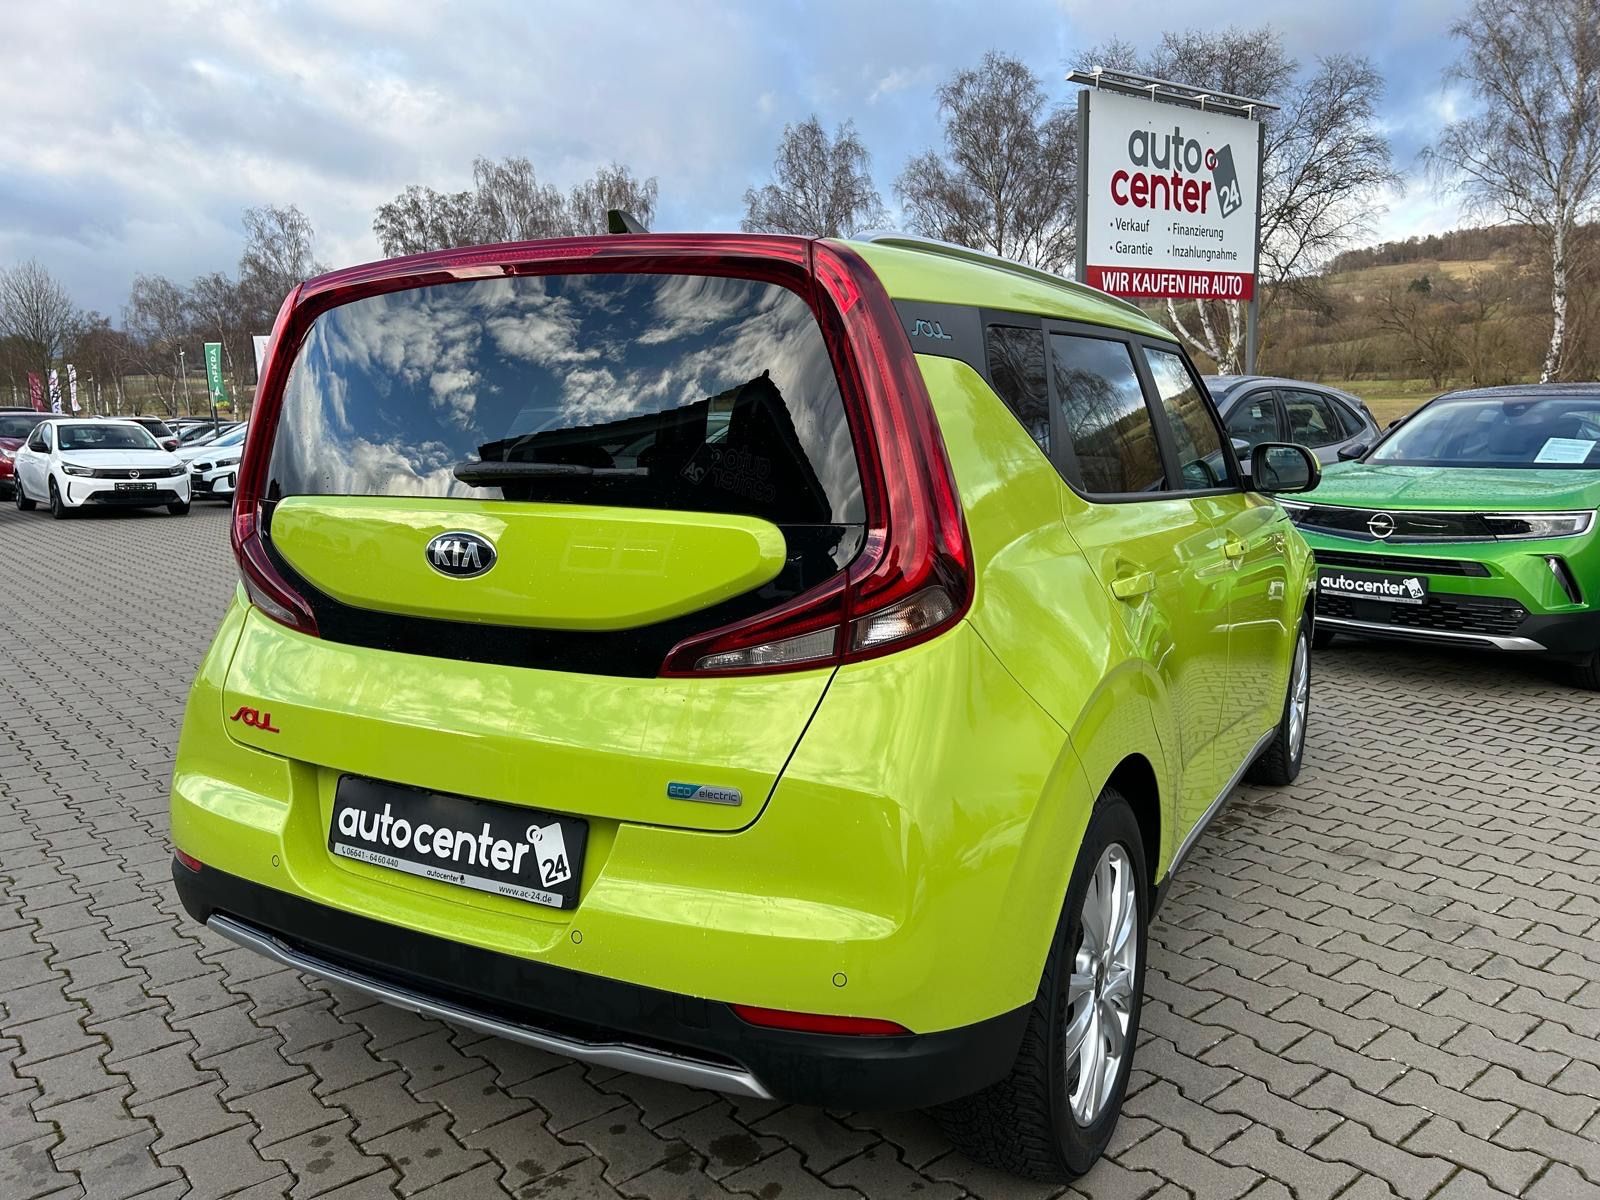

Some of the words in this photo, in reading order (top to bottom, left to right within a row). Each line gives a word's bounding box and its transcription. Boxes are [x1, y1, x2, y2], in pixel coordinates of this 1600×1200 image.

[1128, 126, 1202, 174] auto
[1110, 169, 1212, 214] center
[1219, 179, 1241, 214] 24
[1115, 217, 1150, 233] Verkauf
[1172, 222, 1224, 242] Finanzierung
[1115, 240, 1153, 256] Garantie
[1172, 244, 1238, 262] Inzahlungnahme
[1101, 271, 1129, 292] WIR
[1132, 272, 1187, 294] KAUFEN
[1188, 275, 1209, 295] IHR
[1211, 275, 1243, 296] AUTO
[434, 540, 482, 568] KIA
[1320, 574, 1406, 596] autocenter
[699, 789, 737, 802] electric
[338, 803, 530, 875] autocenter
[541, 853, 568, 883] 24
[498, 885, 553, 904] www.ac-24.de
